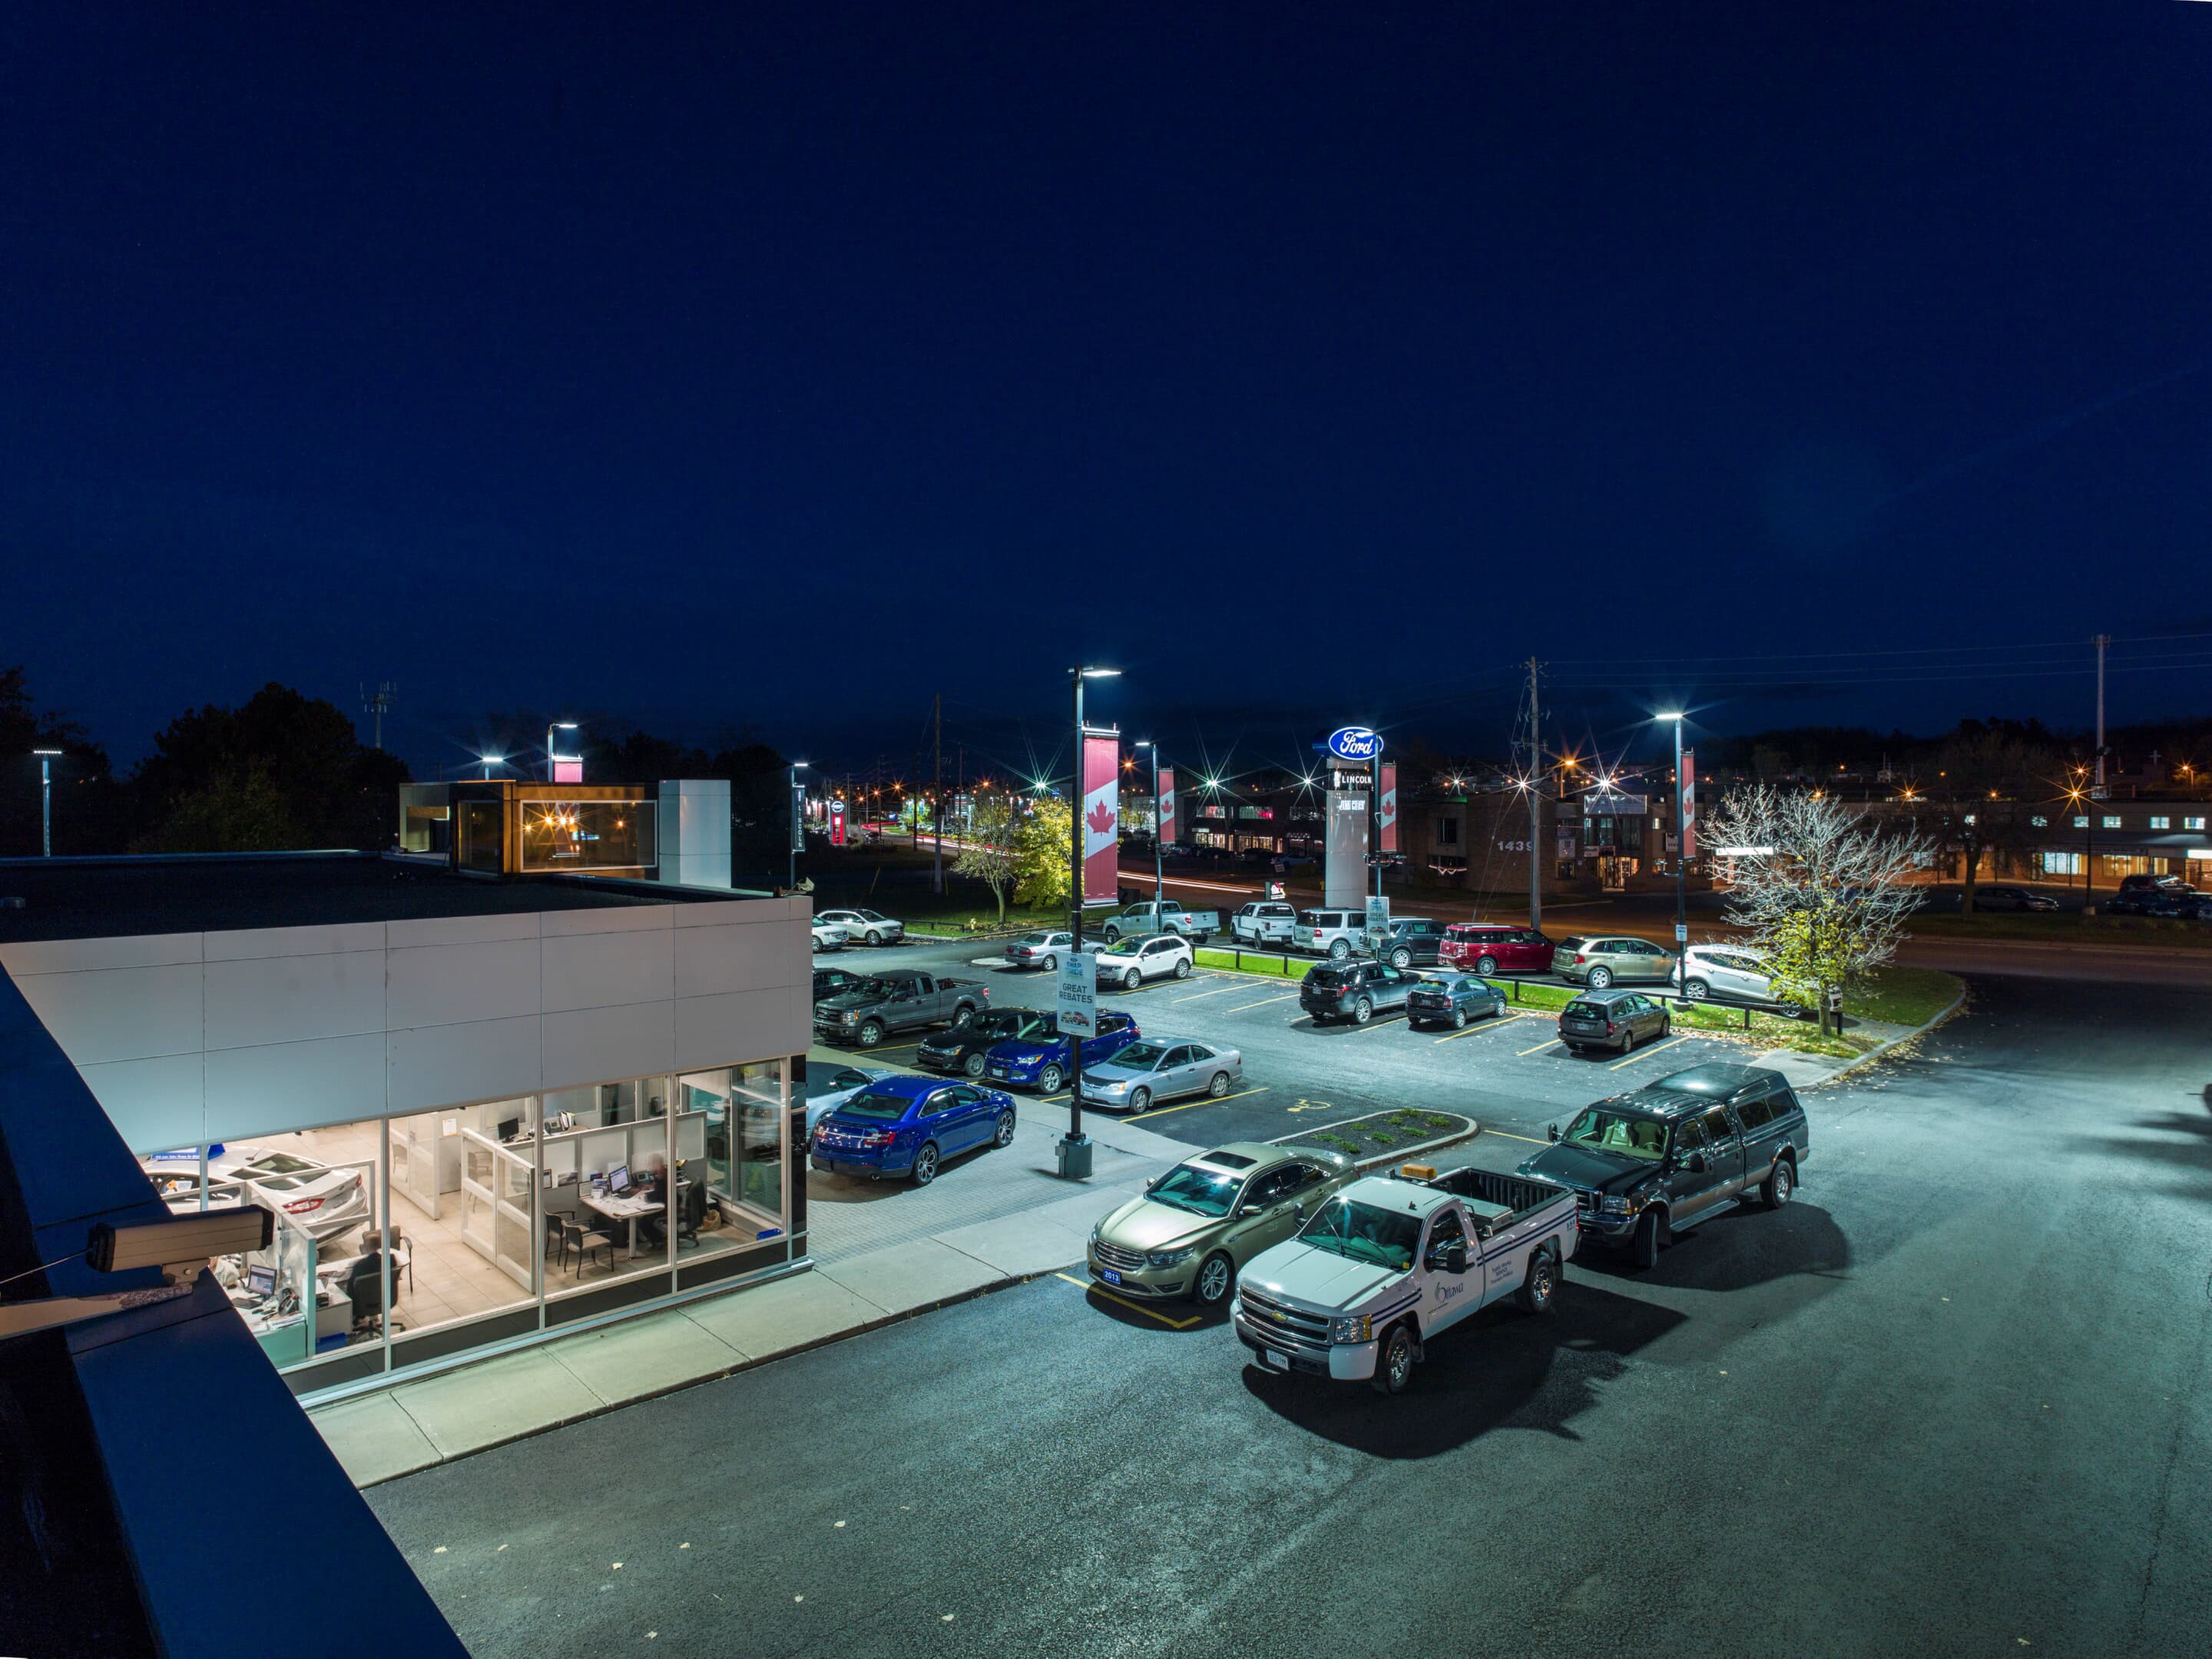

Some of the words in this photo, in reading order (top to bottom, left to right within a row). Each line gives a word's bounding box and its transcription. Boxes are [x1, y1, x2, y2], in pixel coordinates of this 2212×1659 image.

[1340, 731, 1373, 754] Ford
[1063, 982, 1088, 993] GREAT
[1059, 991, 1092, 1003] REBATES
[1104, 1270, 1119, 1281] 2013
[1435, 1282, 1463, 1303] Ottawa
